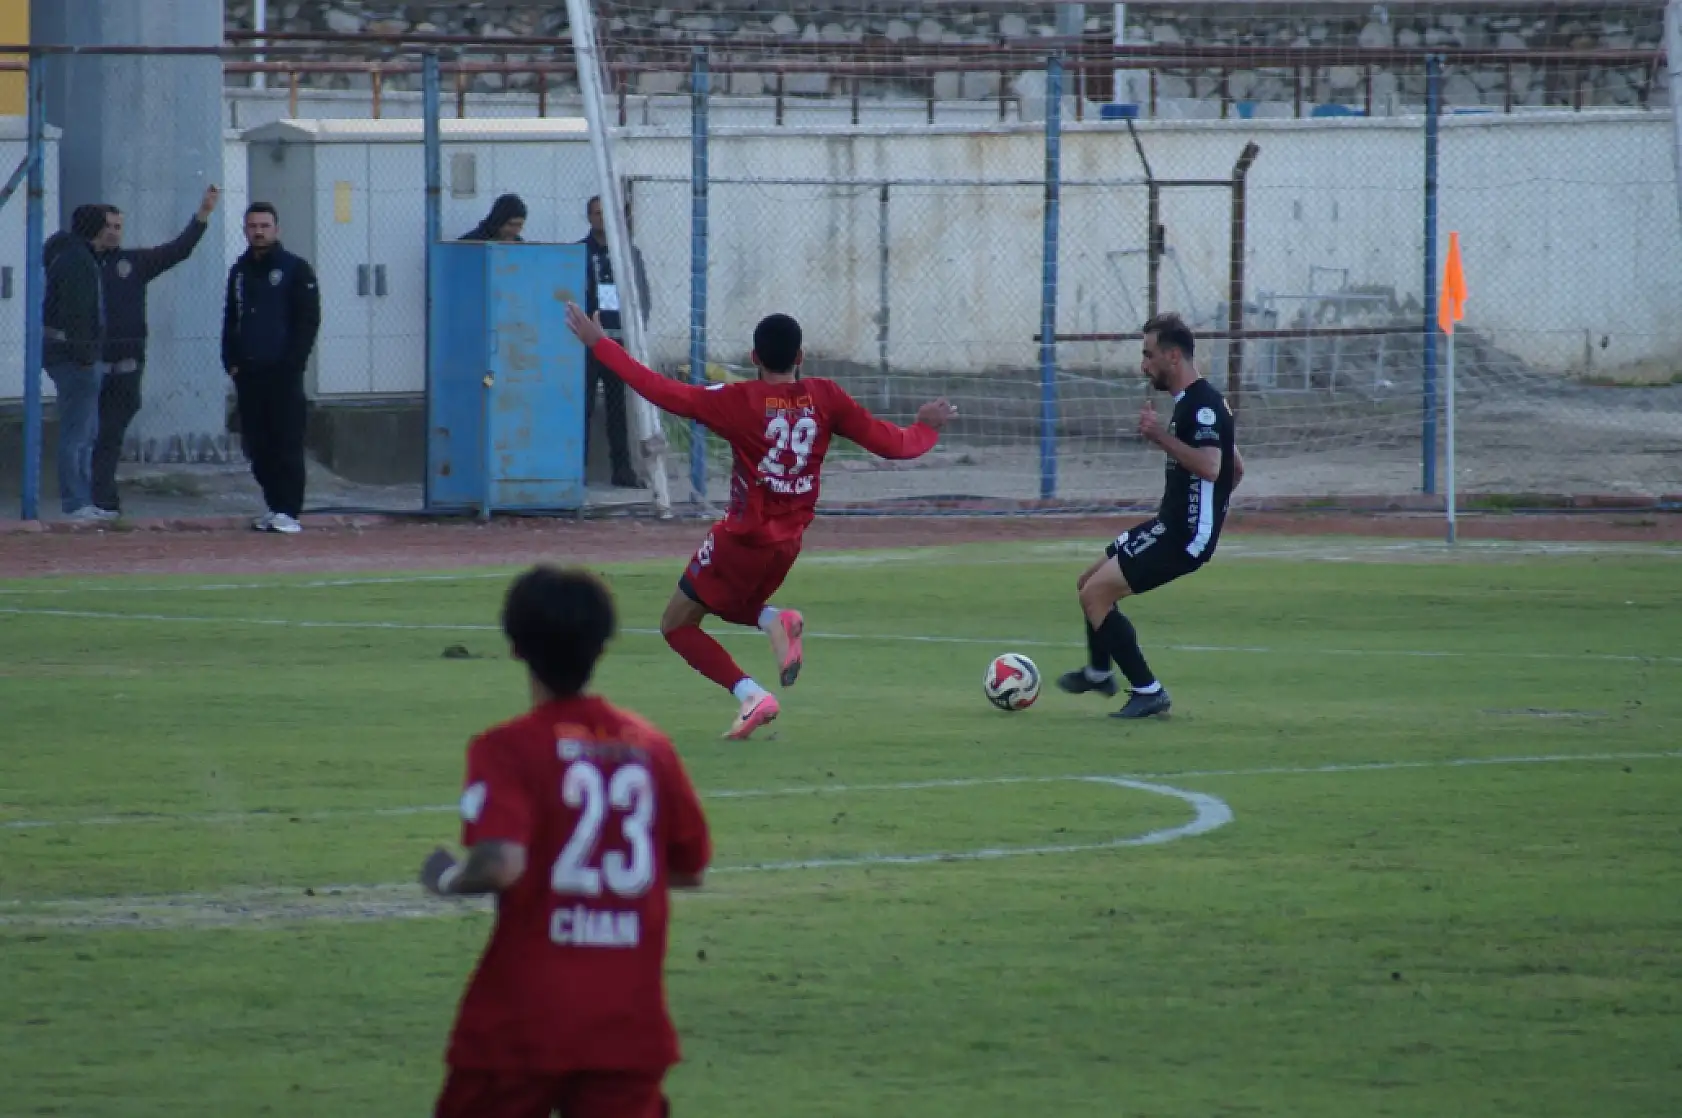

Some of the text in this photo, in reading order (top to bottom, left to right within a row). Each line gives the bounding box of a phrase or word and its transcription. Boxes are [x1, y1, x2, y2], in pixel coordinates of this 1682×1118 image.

[758, 417, 818, 476] 29
[551, 760, 656, 896] 23
[549, 904, 640, 947] CİHAN
